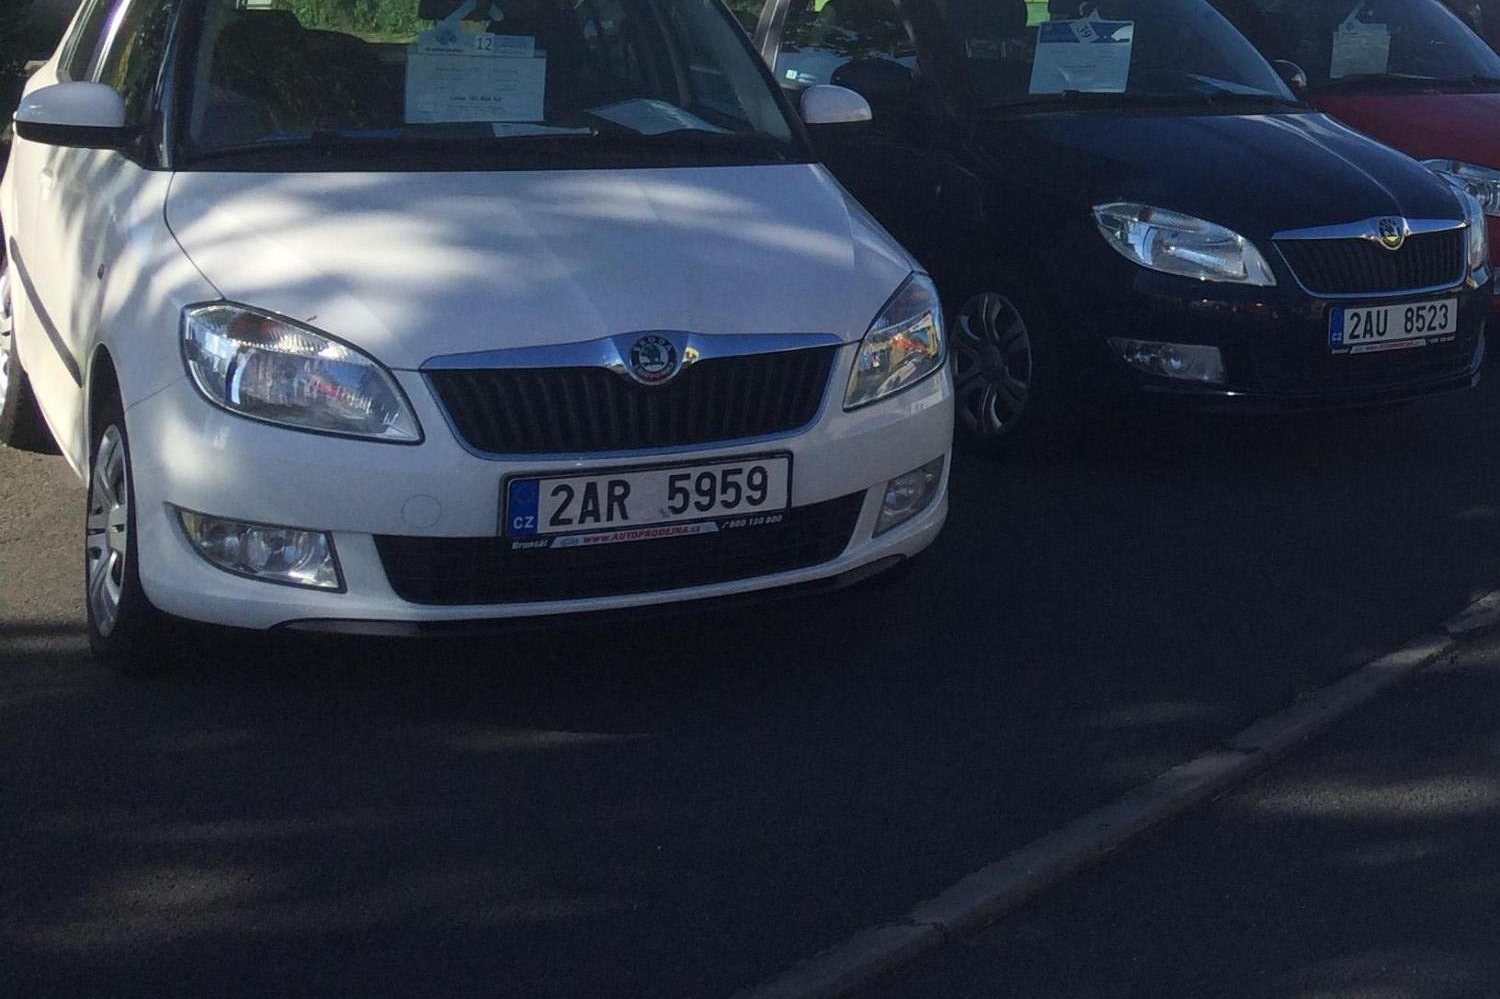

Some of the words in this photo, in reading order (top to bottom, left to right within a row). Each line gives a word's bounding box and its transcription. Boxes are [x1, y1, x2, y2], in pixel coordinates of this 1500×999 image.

[476, 37, 493, 51] 12
[1349, 308, 1388, 340] 2AU
[1403, 304, 1449, 335] 8523
[512, 515, 535, 530] CZ
[548, 479, 631, 527] 2AR
[667, 465, 769, 516] 5959
